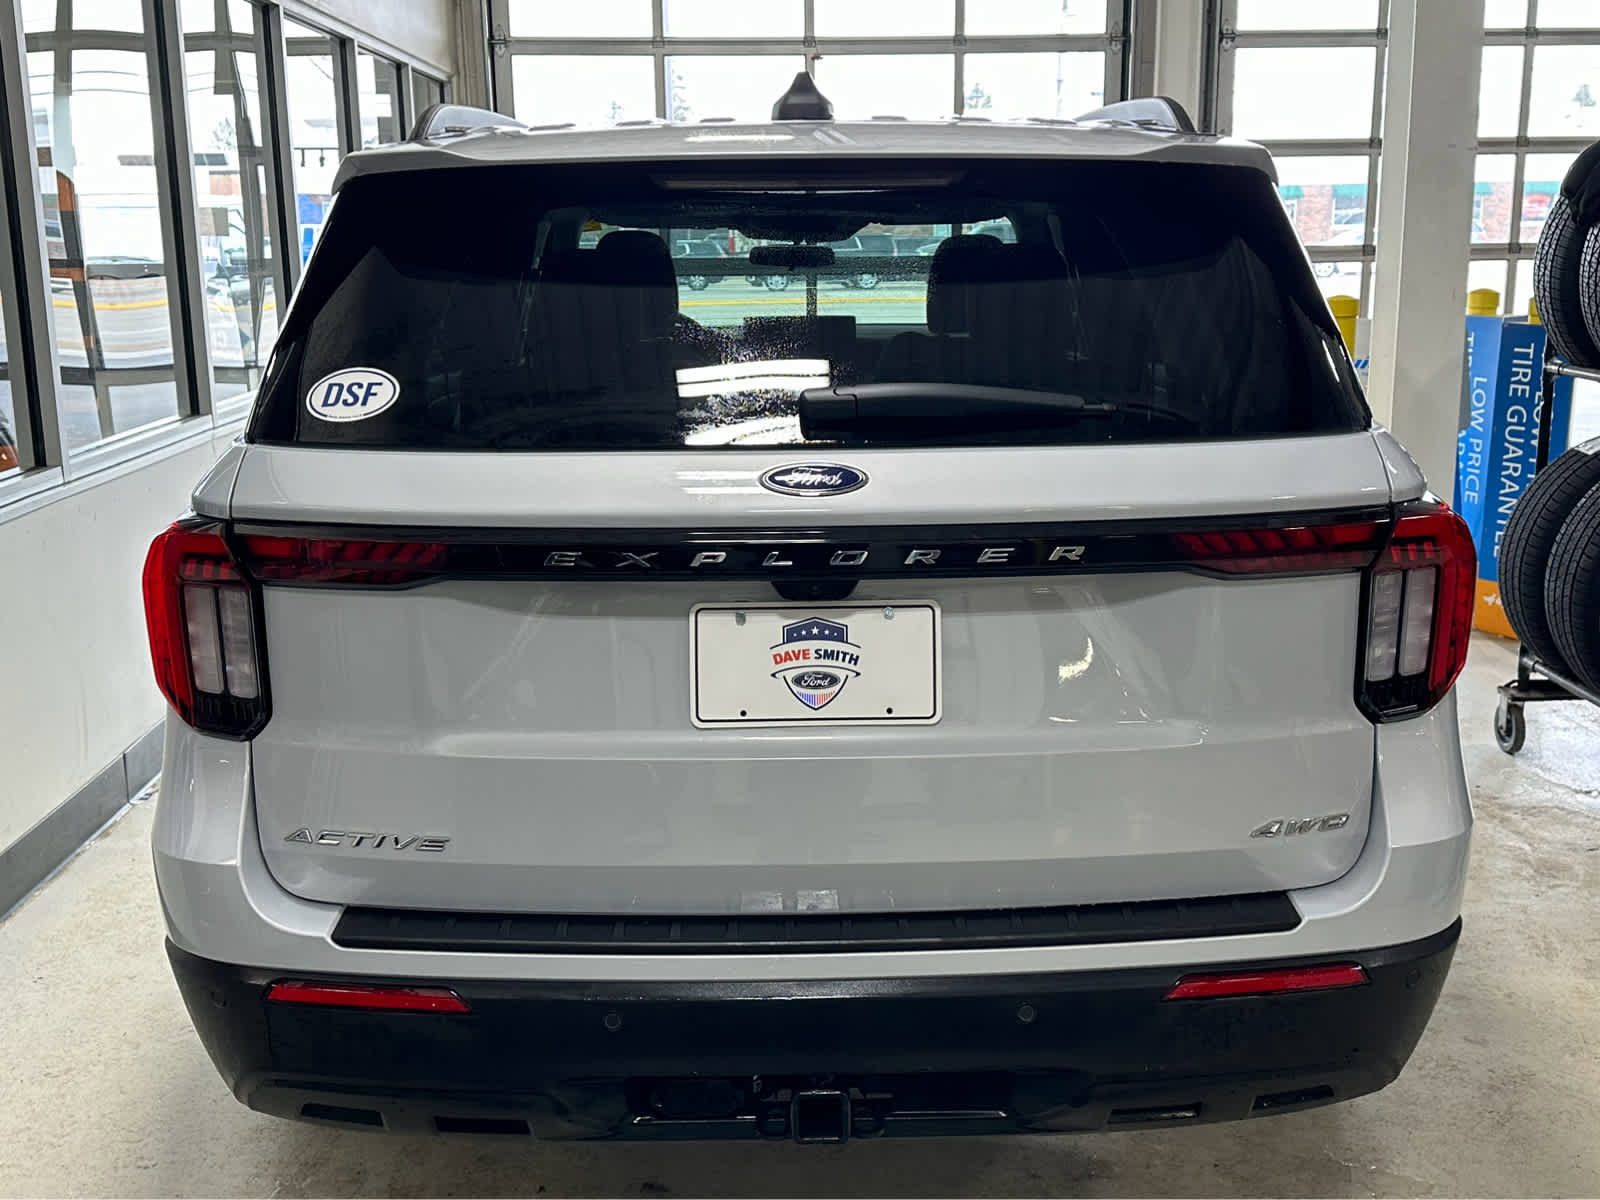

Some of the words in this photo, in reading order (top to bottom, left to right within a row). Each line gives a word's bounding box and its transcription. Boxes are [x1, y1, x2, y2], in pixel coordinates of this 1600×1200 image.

[1509, 343, 1535, 398] TIRE
[321, 382, 383, 407] DSF
[1470, 376, 1488, 432] LOW
[1464, 438, 1483, 504] PRICE
[1493, 405, 1527, 558] GUARAN
[543, 546, 1086, 568] EXPLORER
[773, 649, 810, 665] DAVE
[814, 649, 860, 666] SMITH
[801, 672, 831, 687] Ford
[1250, 814, 1350, 838] 4WD
[284, 827, 450, 852] ACTIVE
